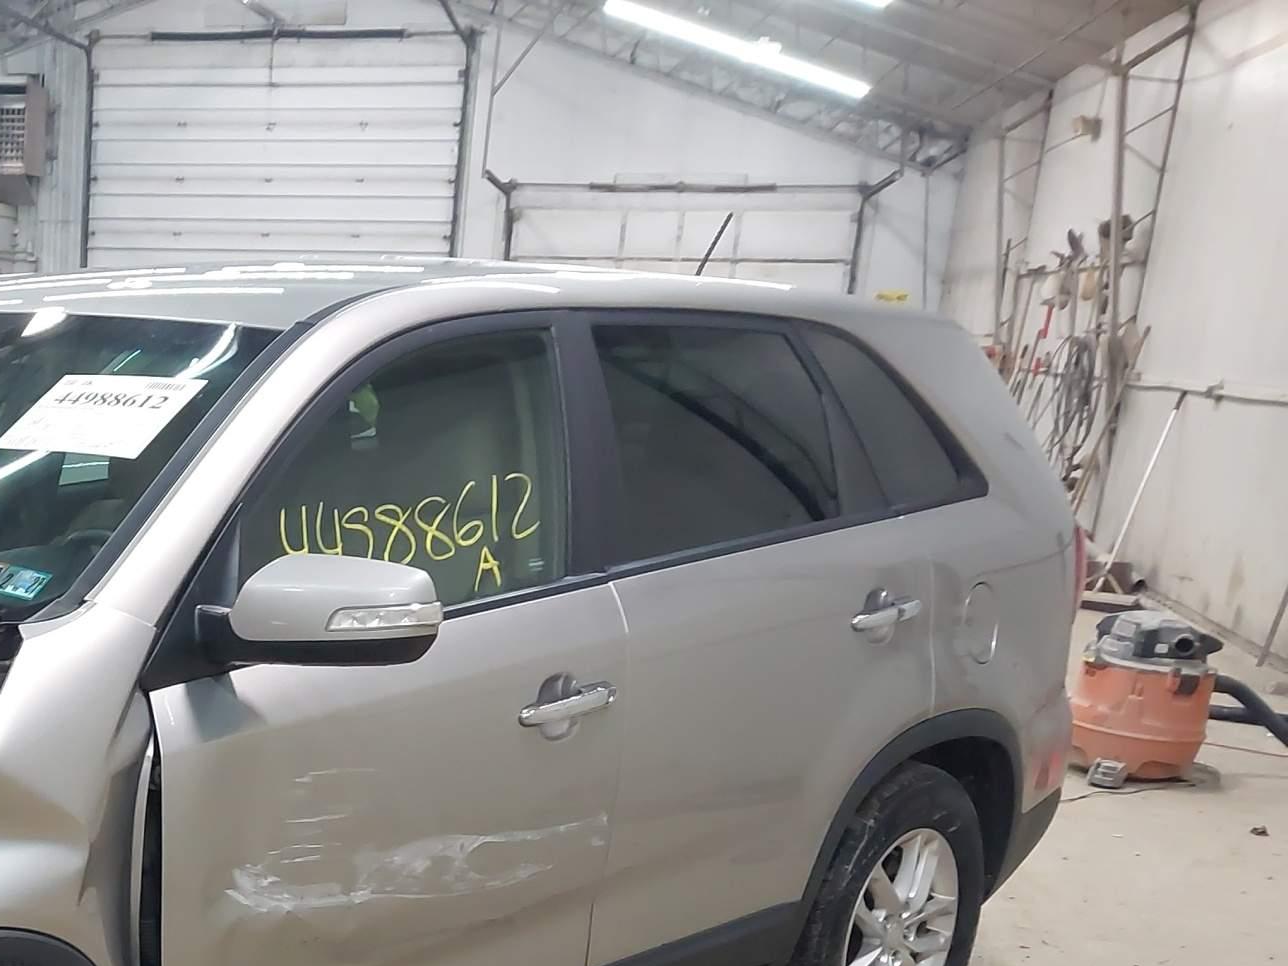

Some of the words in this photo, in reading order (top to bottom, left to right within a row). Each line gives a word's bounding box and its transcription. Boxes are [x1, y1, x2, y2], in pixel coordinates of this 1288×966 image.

[54, 391, 170, 410] 44988612
[279, 472, 540, 566] 44988612
[474, 545, 502, 592] A
